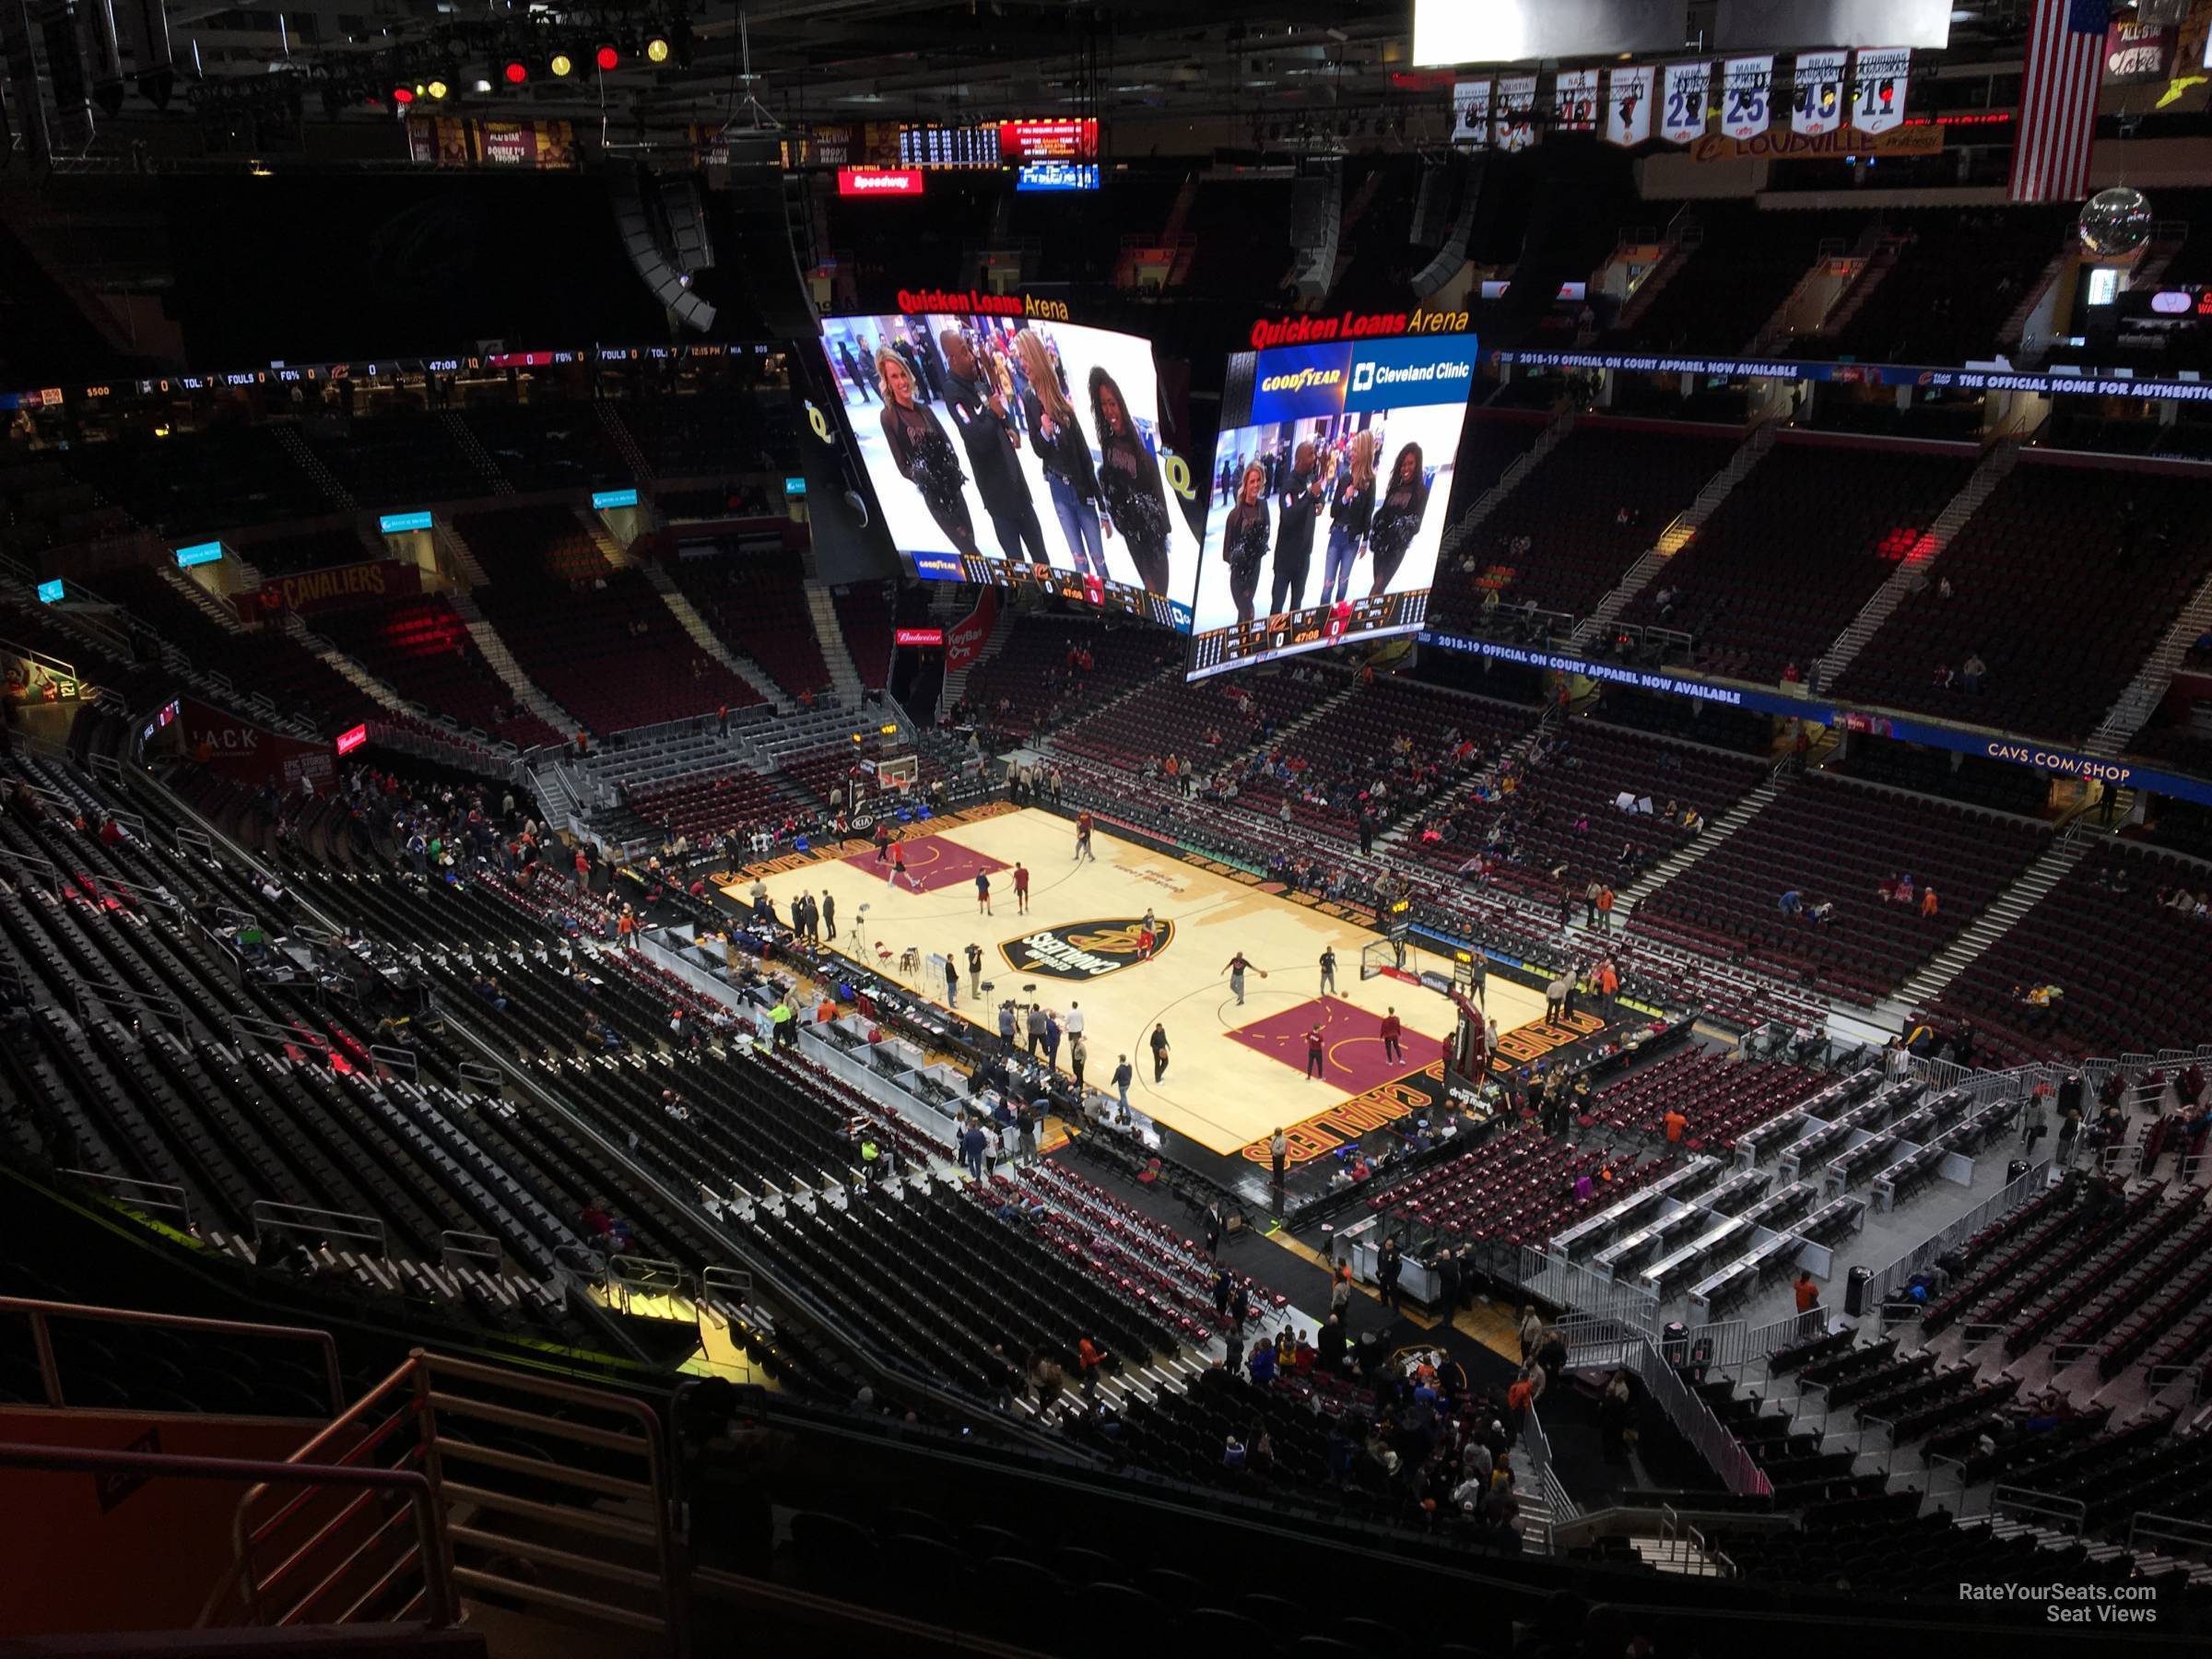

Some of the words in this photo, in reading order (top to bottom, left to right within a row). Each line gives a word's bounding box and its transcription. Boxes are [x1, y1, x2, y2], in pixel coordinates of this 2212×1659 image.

[1735, 62, 1762, 72] MARK
[1807, 57, 1834, 68] BRAD
[1726, 88, 1765, 124] 25
[1735, 129, 1877, 156] LOUDVILLE
[853, 175, 909, 189] Speedway
[897, 288, 969, 314] Quicken
[971, 289, 1023, 314] Loans
[1024, 293, 1070, 322] Arena
[1250, 314, 1339, 350] Quicken
[1340, 311, 1407, 337] Loans
[1407, 308, 1469, 333] Arena
[160, 379, 169, 393] 0
[183, 378, 204, 390] TOL:
[206, 376, 214, 388] 7
[228, 373, 254, 385] FOULS
[258, 371, 265, 384] 0
[280, 370, 300, 382] FG%
[307, 368, 315, 380] 0
[369, 364, 376, 376] 0
[429, 359, 458, 372] 47:08
[526, 353, 534, 365] 0
[555, 352, 572, 363] FG%
[577, 351, 584, 362] 0
[601, 349, 627, 360] FOULS
[630, 347, 638, 359] 0
[651, 347, 669, 359] TOL:
[671, 347, 678, 358] 7
[710, 345, 721, 356] PM
[1375, 363, 1435, 384] Cleveland
[1436, 360, 1470, 379] Clinic
[1520, 352, 1559, 367] 2018-19
[1561, 355, 1604, 368] OFFICIAL
[1606, 357, 1622, 369] ON
[1623, 358, 1658, 371] COURT
[1659, 359, 1705, 372] APPAREL
[1707, 362, 1735, 374] NOW
[1736, 364, 1798, 378] AVAILABLE
[1261, 367, 1341, 393] GOODYEAR
[1959, 374, 1985, 388] THE
[1987, 376, 2048, 392] OFFICIAL
[2051, 379, 2095, 394] HOME
[2099, 382, 2129, 395] FOR
[1166, 455, 1196, 500] Q
[919, 559, 957, 571] GOODYEAR
[282, 564, 385, 611] CAVALIERS
[1045, 581, 1053, 594] 0
[1090, 589, 1099, 603] 0
[1293, 612, 1302, 624] 1Q
[898, 631, 942, 643] Budweiser
[1276, 632, 1285, 648] 0
[1294, 629, 1320, 643] 47:08
[1331, 620, 1340, 636] 0
[1438, 635, 1480, 653] 2018-19
[1482, 644, 1528, 664] OFFICIAL
[1530, 653, 1547, 665] ON
[1549, 656, 1586, 674] COURT
[1588, 664, 1639, 685] APPAREL
[1641, 675, 1673, 691] NOW
[1674, 680, 1742, 706] AVAILABLE
[282, 759, 300, 771] EPIC
[1987, 742, 2131, 782] CAVS.COM/SHOP
[855, 818, 870, 828] KIA
[1021, 931, 1122, 975] CAVALIERS
[1025, 949, 1072, 972] CLEVELAND
[1449, 1086, 1470, 1105] drug
[1469, 1097, 1494, 1116] mart
[1241, 1082, 1433, 1172] CAVALIERS
